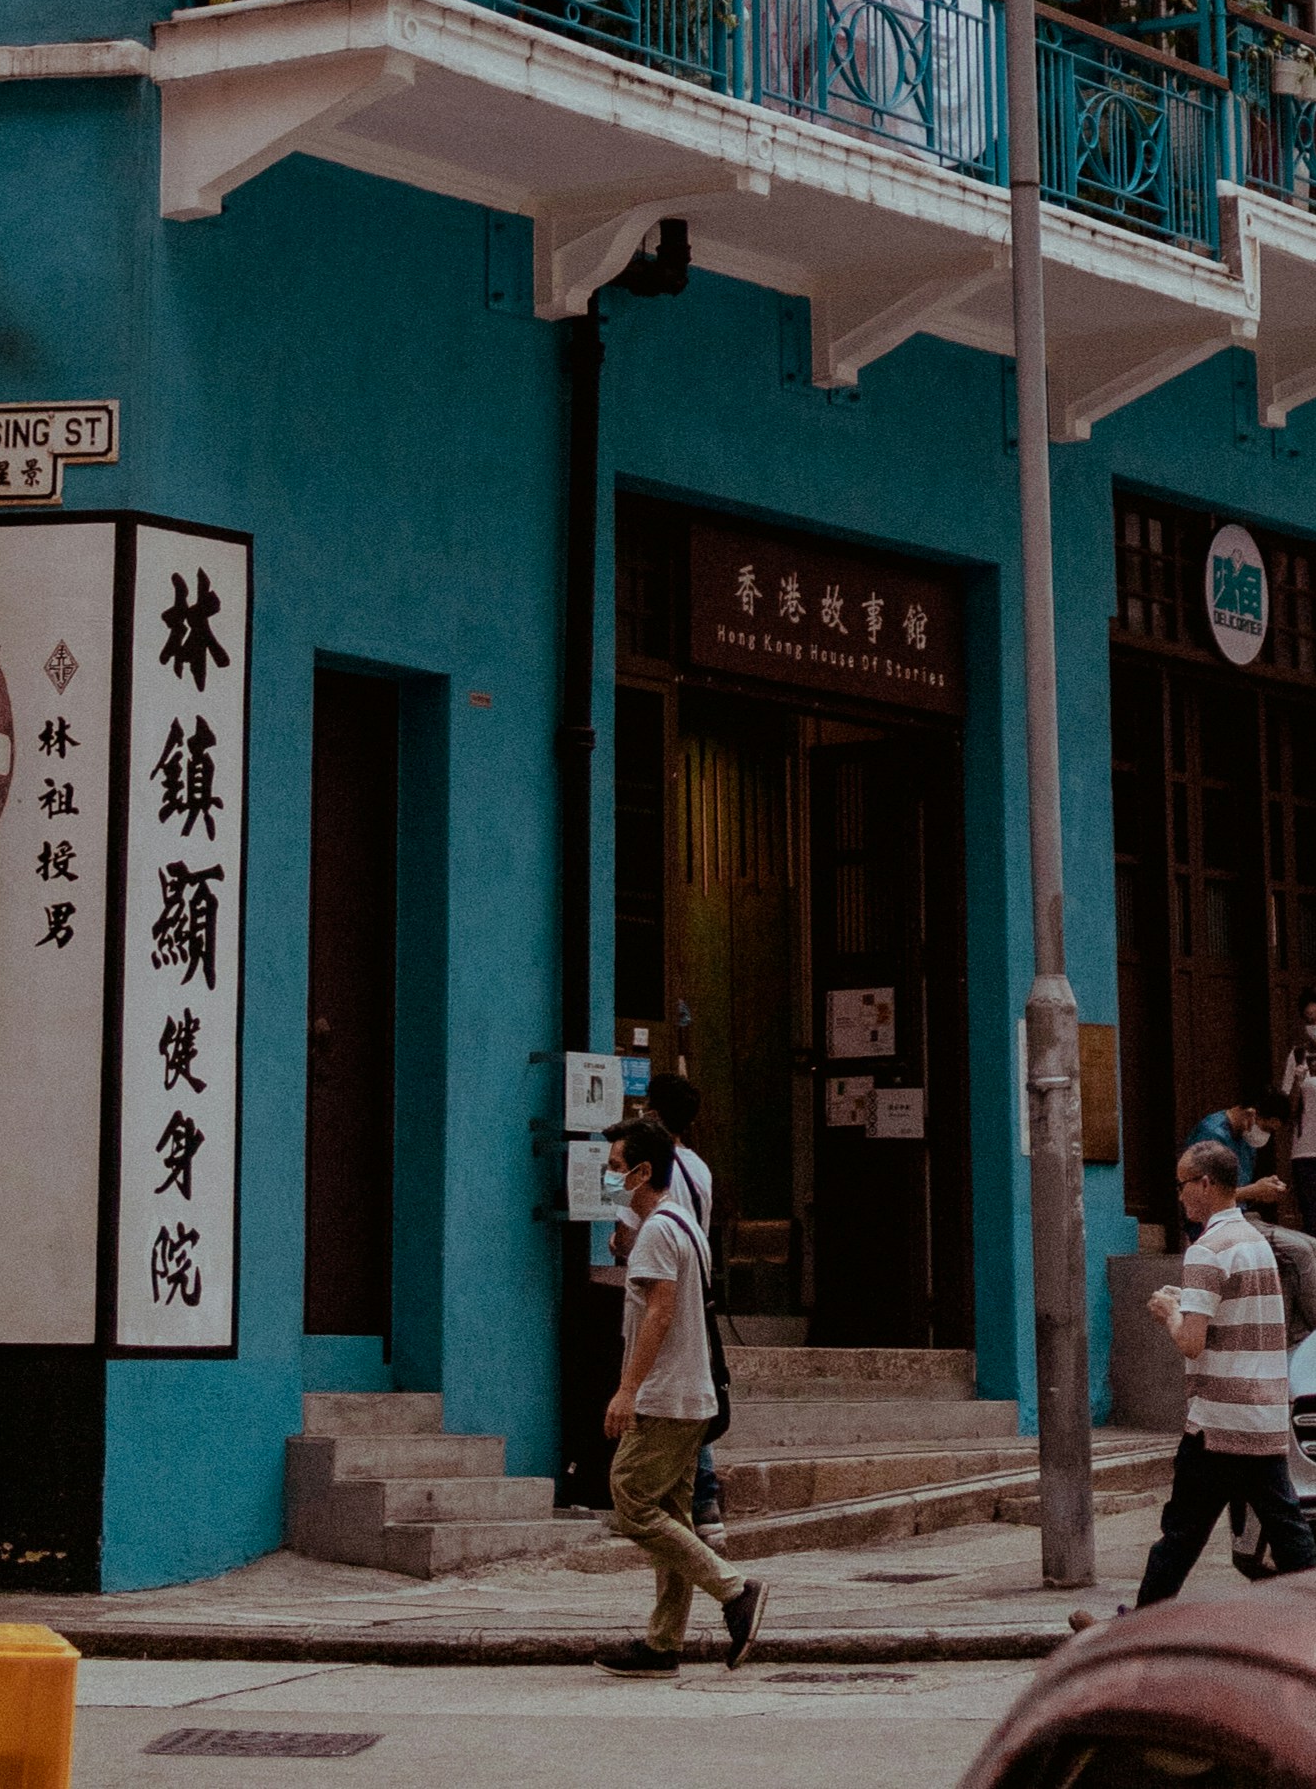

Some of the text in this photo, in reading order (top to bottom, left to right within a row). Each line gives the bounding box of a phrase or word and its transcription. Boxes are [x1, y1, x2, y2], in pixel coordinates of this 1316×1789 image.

[717, 623, 945, 688] Hong Kong House Of Stories
[735, 564, 929, 651] 香港故事館
[35, 716, 80, 949] 林祖授男
[150, 567, 230, 1306] 林鎮顯健身院
